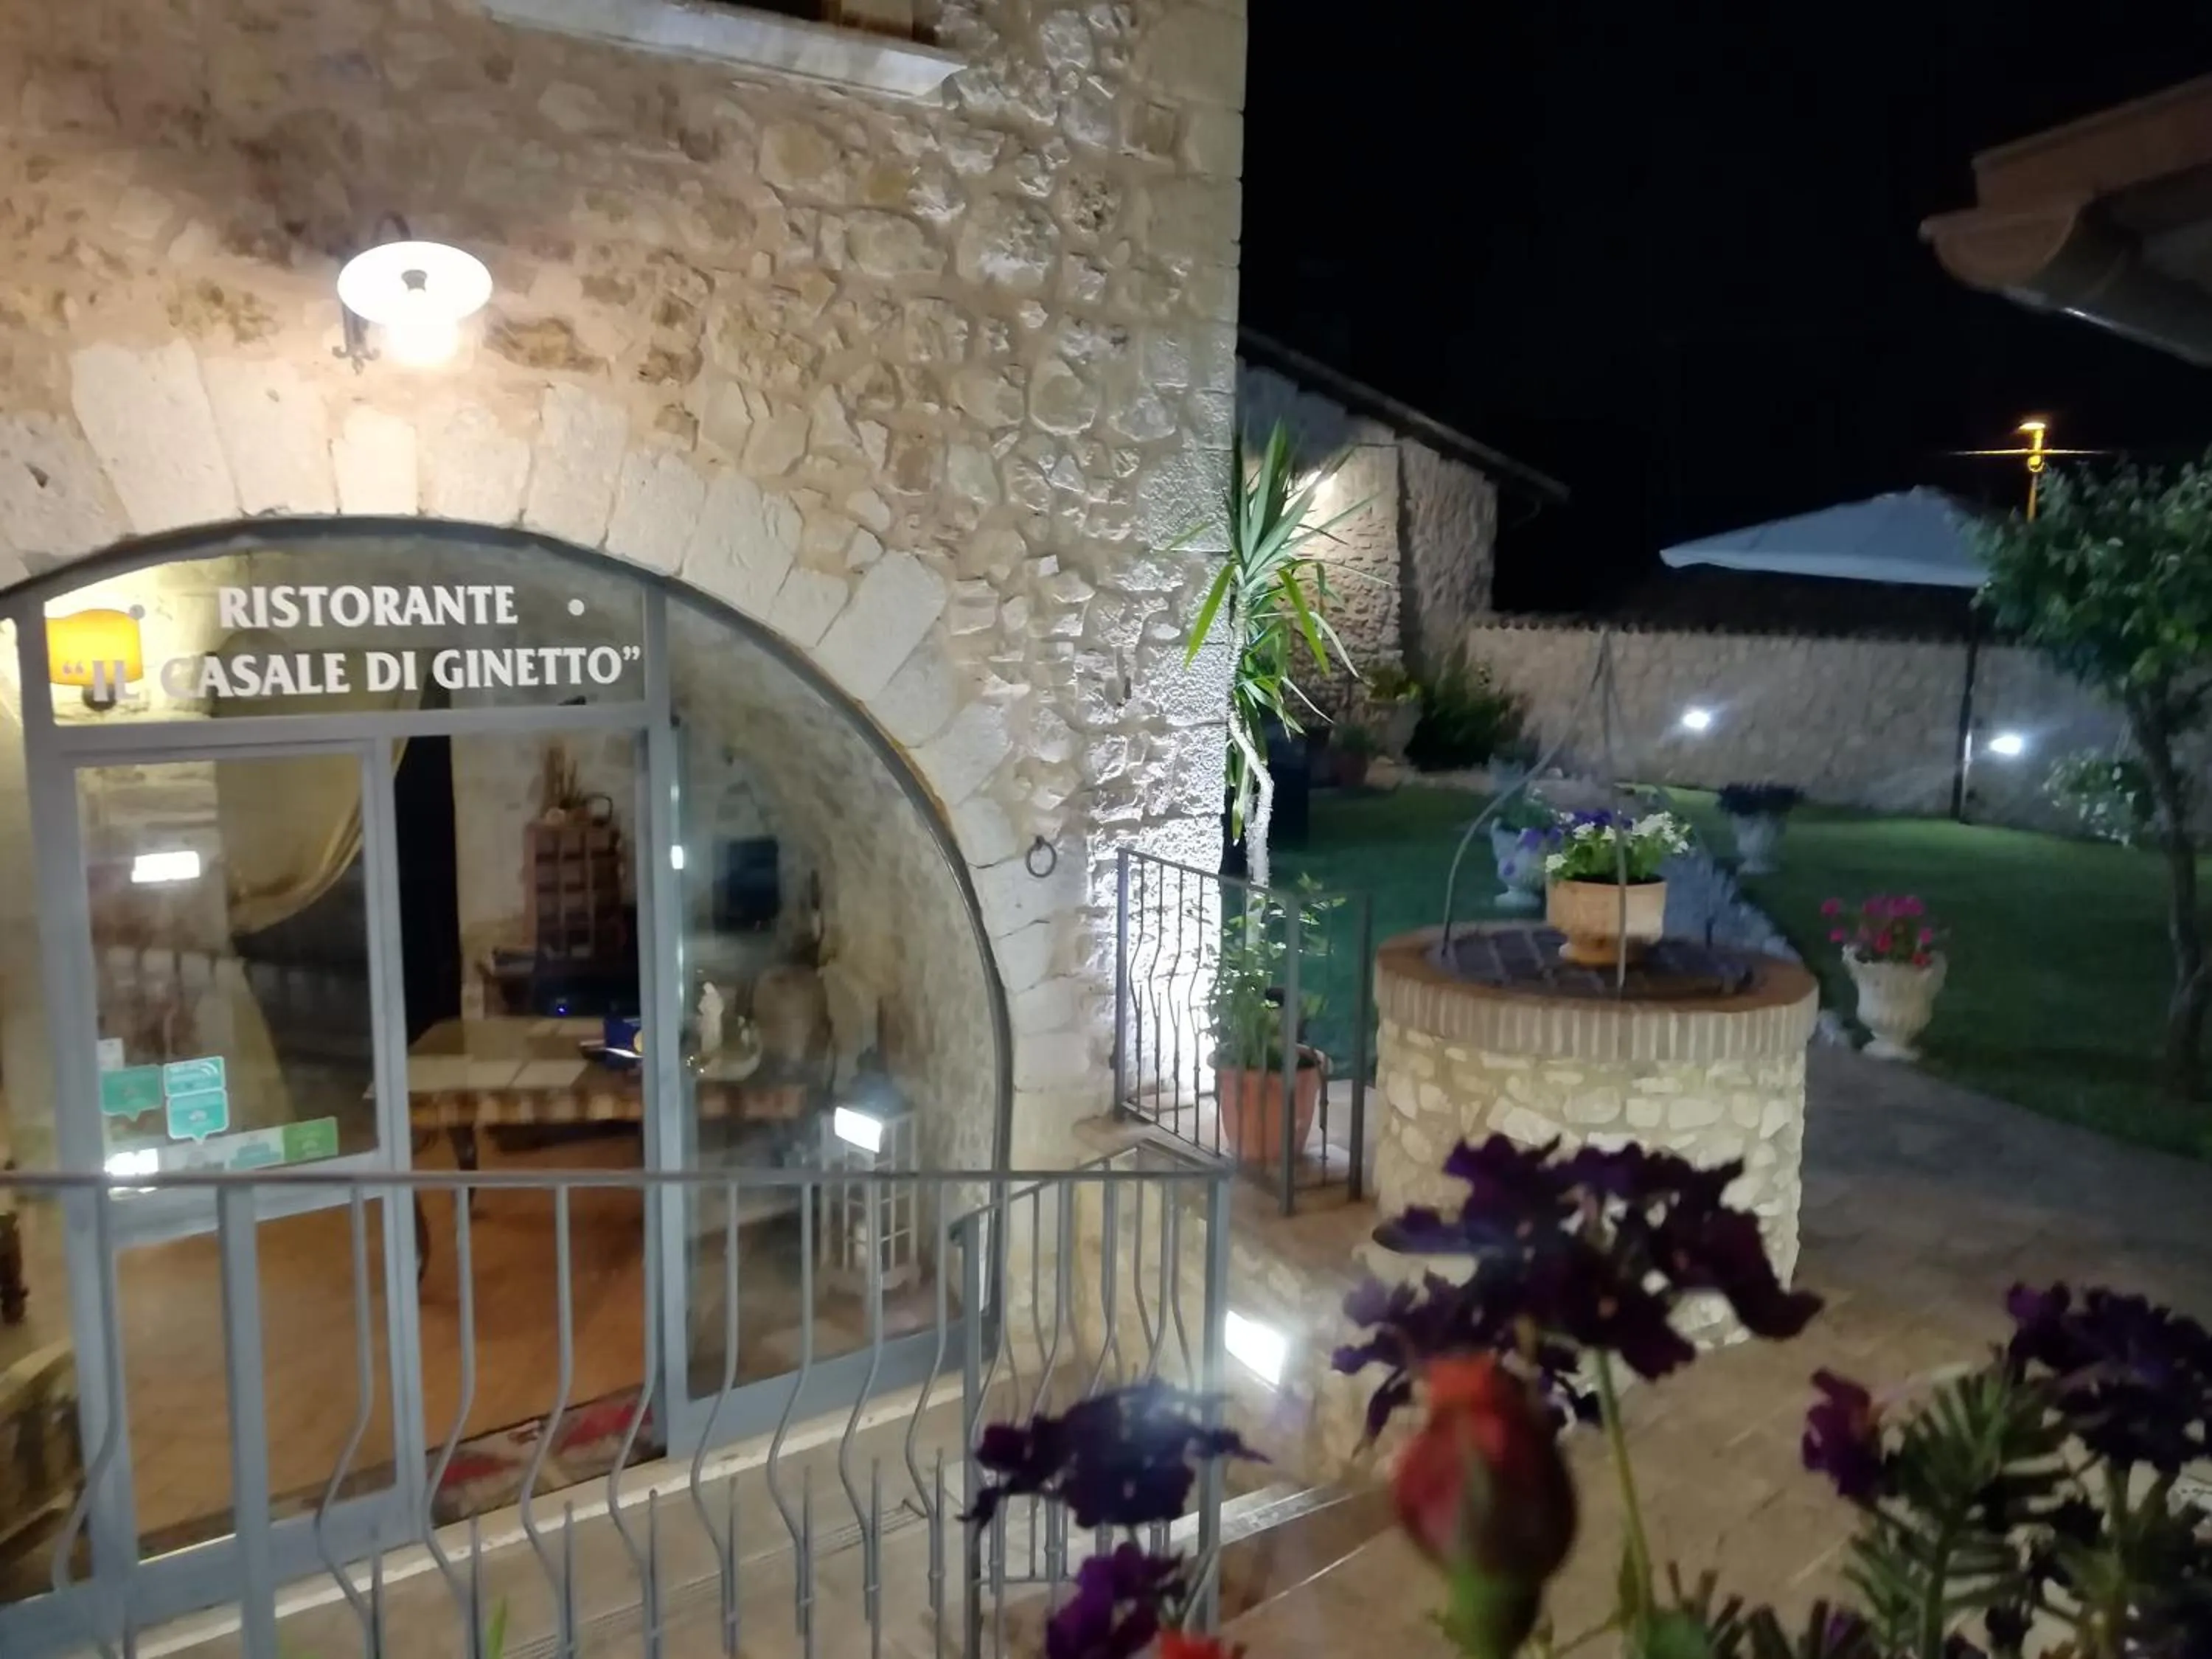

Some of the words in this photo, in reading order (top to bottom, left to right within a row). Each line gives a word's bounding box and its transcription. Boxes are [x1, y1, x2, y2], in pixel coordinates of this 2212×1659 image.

[219, 585, 518, 628] RISTORANTE
[161, 653, 350, 698] CASALE
[366, 650, 418, 692] DI
[433, 646, 641, 689] GINETTO”
